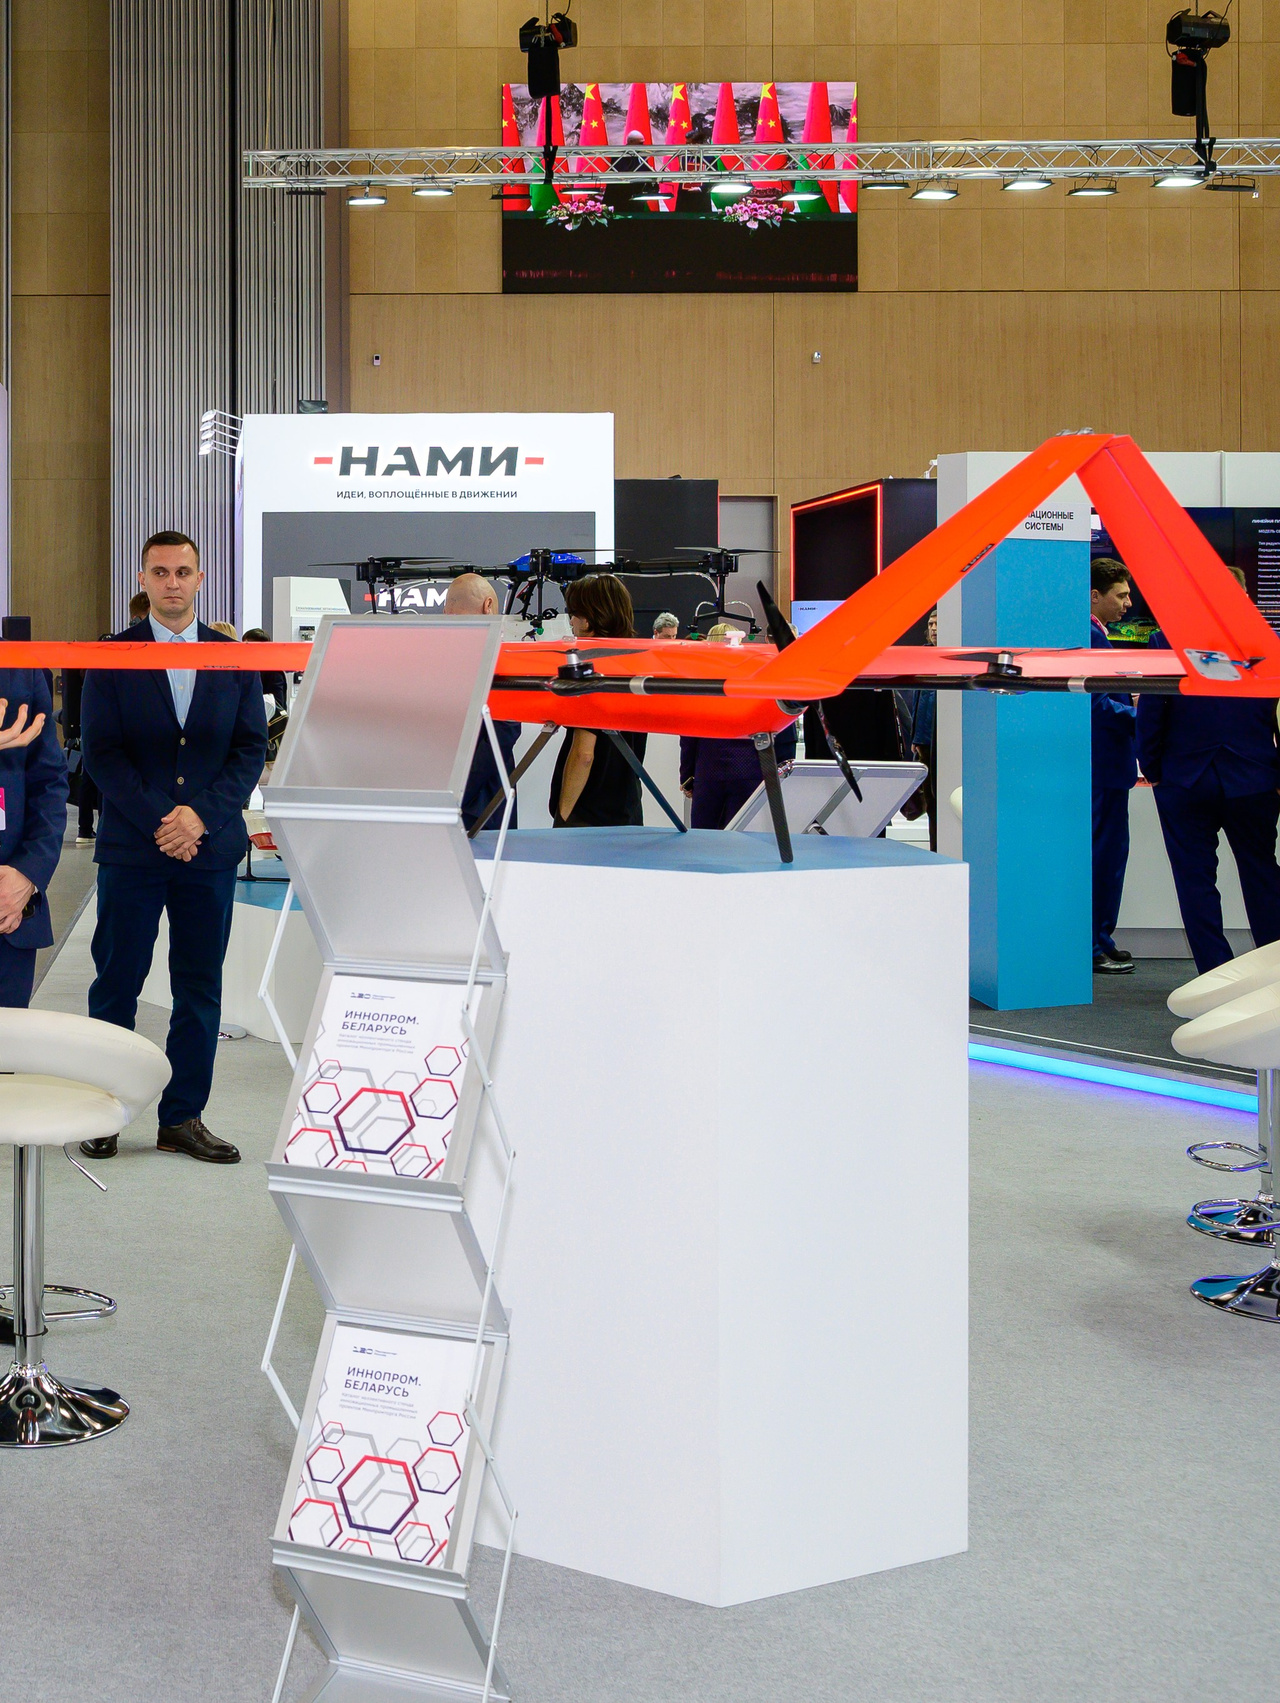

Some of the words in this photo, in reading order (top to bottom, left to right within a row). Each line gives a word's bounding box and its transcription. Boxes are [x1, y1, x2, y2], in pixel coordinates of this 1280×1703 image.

[339, 446, 519, 476] НАМИ
[336, 491, 367, 499] ИДЕИ,
[369, 489, 449, 499] ВОПЛОЩЁННЫЕ
[452, 491, 458, 499] В
[459, 491, 518, 499] ДВИЖЕНИИ
[1028, 511, 1074, 520] АЦИОННЫЕ
[1024, 521, 1064, 531] СИСТЕМЫ
[377, 588, 448, 607] НАМ
[344, 1010, 419, 1025] ИННОПРОМ.
[341, 1021, 407, 1035] БЕЛАРУСЬ
[347, 1366, 422, 1387] ИННОПРОМ.
[344, 1379, 409, 1398] БЕЛАРУСЬ
